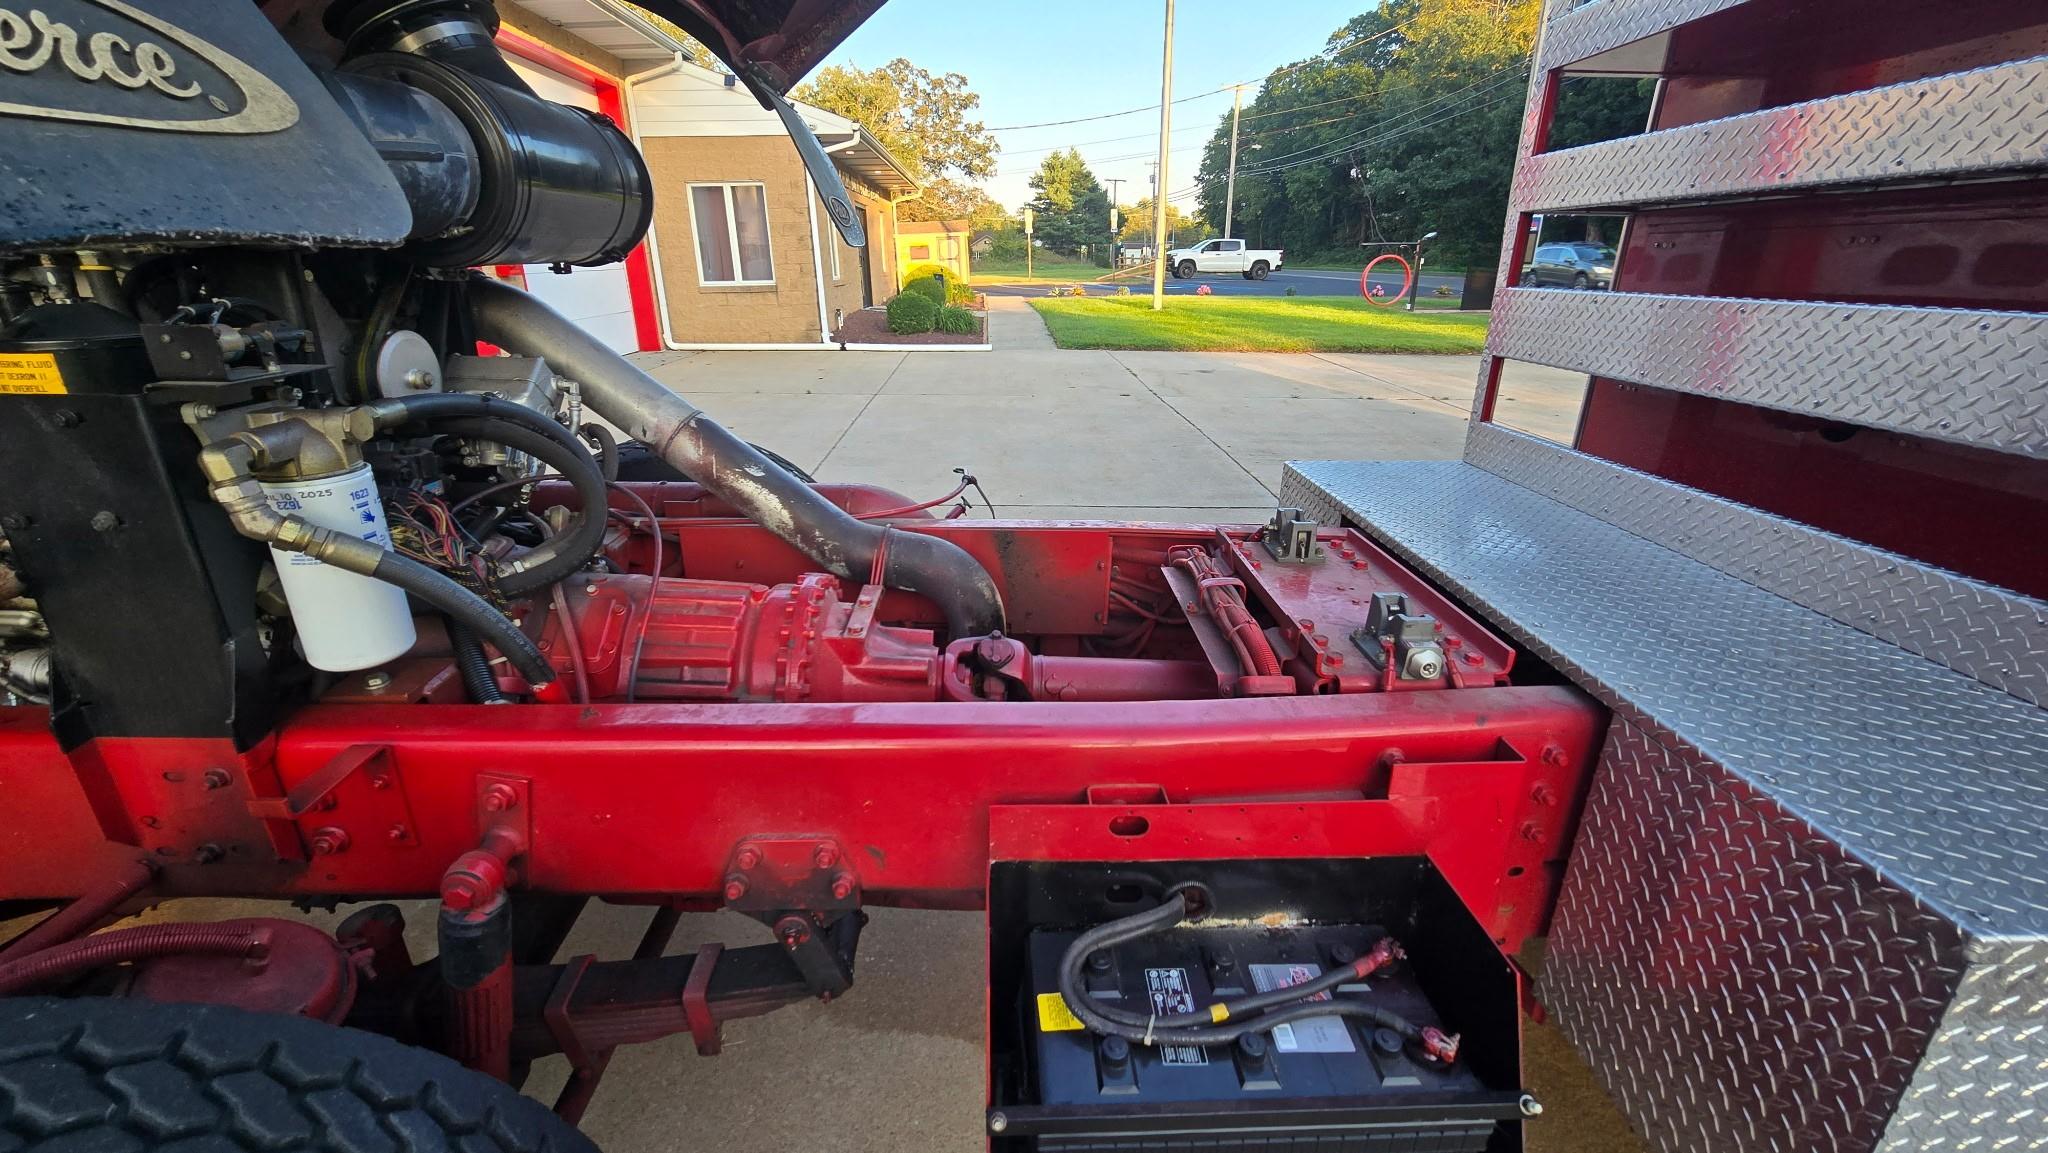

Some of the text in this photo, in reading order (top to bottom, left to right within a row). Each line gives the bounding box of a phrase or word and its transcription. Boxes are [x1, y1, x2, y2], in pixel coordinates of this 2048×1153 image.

[26, 360, 53, 368] FLUID
[298, 488, 333, 499] 2025
[349, 488, 369, 501] 1623
